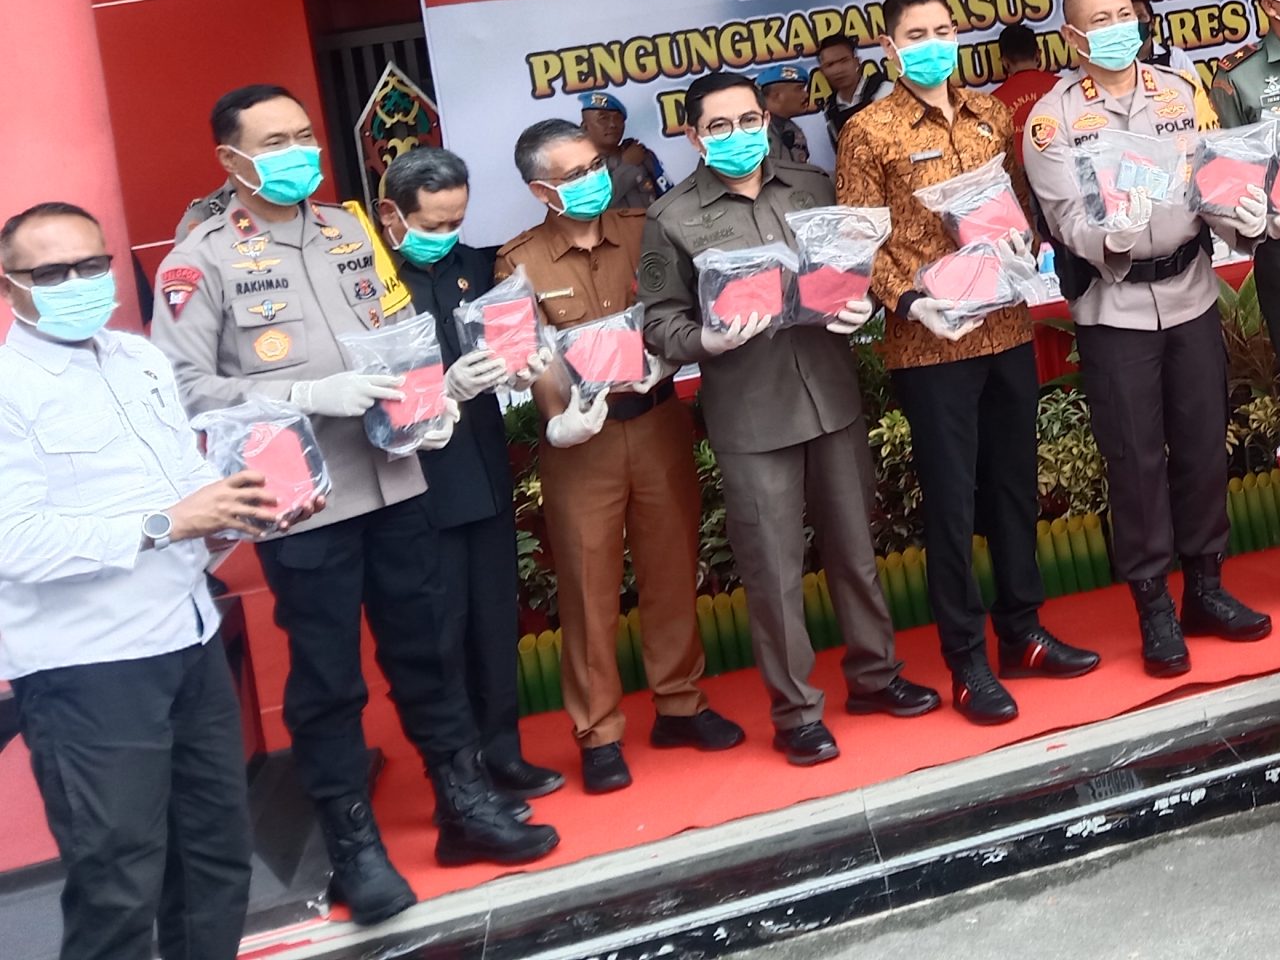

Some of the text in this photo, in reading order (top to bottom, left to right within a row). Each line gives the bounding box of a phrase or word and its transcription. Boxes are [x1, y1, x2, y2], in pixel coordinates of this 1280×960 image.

[1155, 117, 1194, 135] POLRI
[337, 255, 373, 274] POLRI
[236, 278, 289, 295] RAKHMAD
